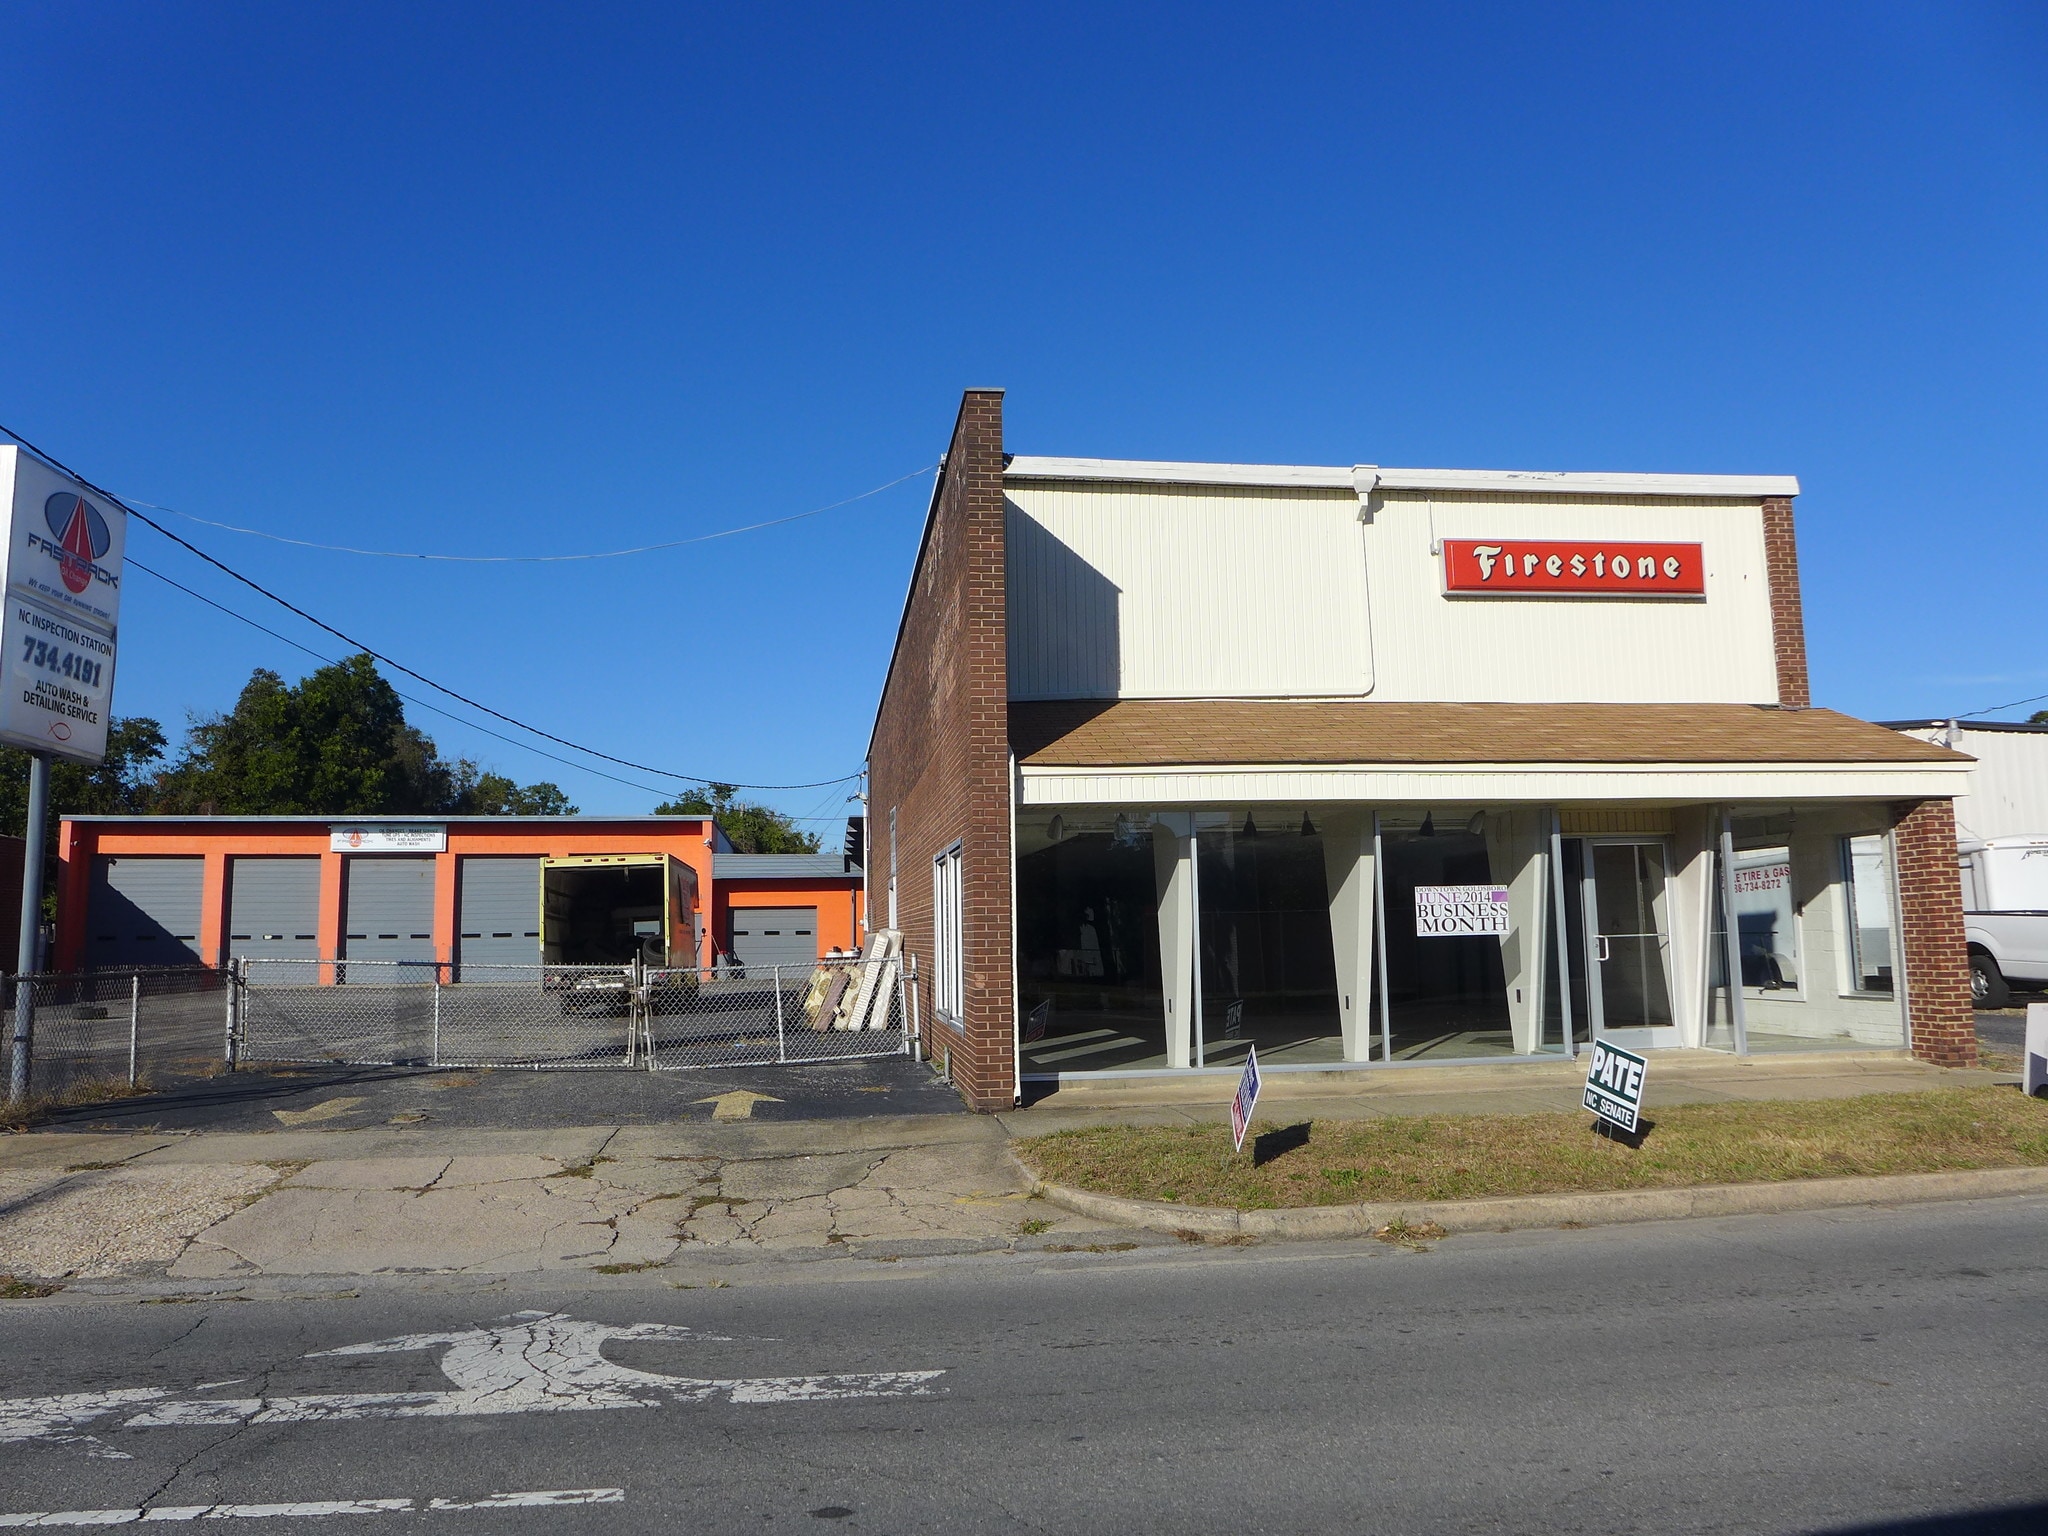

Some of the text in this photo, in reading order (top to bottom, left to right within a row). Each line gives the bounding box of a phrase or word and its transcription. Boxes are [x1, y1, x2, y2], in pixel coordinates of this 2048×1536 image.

[28, 532, 118, 589] FASTRACK
[1473, 546, 1681, 581] Firestone
[19, 608, 112, 656] NC INSPECTION STATION
[23, 634, 102, 688] 734.4191
[23, 690, 98, 724] DETAILING SERVICE
[36, 679, 89, 707] AUTO WASH &
[1743, 871, 1761, 881] TIRE
[1764, 870, 1769, 879] &
[1773, 867, 1790, 877] GAS
[1417, 891, 1491, 904] JUNE 2014
[1418, 903, 1508, 918] BUSINESS
[1422, 917, 1508, 932] MONTH
[1589, 1046, 1643, 1099] PATE
[1585, 1091, 1633, 1125] NC SENATE
